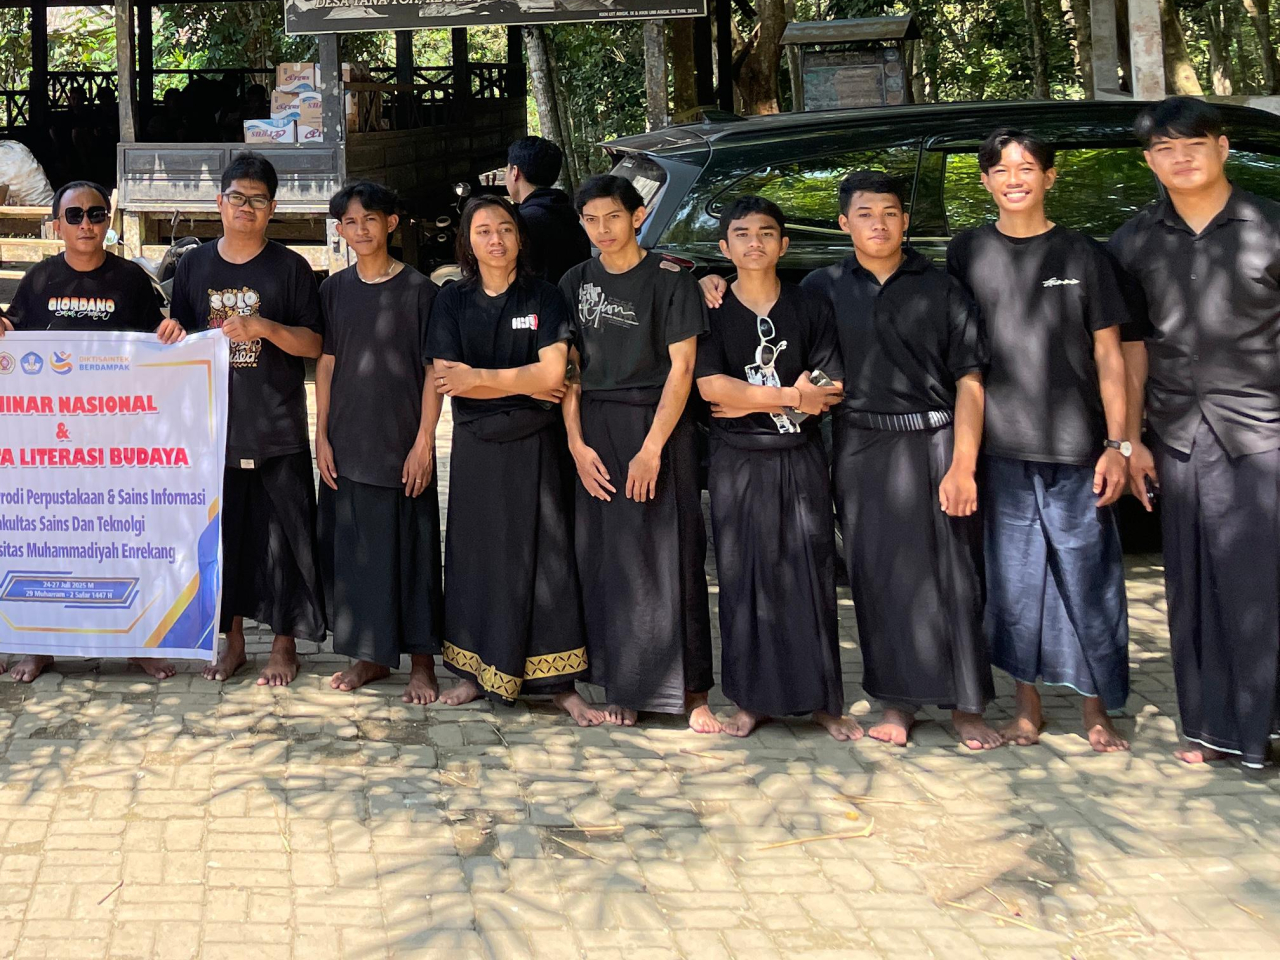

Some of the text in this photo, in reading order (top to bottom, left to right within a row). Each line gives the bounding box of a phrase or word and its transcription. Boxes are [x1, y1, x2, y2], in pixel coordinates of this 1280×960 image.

[48, 296, 115, 312] GIORDANO
[210, 292, 258, 310] SOLO
[78, 355, 130, 364] DIKTISAINTEK
[78, 363, 130, 372] BERDAMPAK
[58, 394, 158, 414] NASIONAL
[55, 422, 70, 441] &
[20, 447, 104, 467] LITERASI
[109, 447, 189, 467] BUDAYA
[26, 488, 105, 509] Perpustakaan
[107, 489, 116, 506] &
[117, 488, 149, 506] Sains
[150, 488, 206, 506] Informasi
[39, 515, 69, 532] Sains
[72, 516, 95, 532] Dan
[97, 515, 146, 537] Teknolgi
[26, 541, 120, 563] Muhammadiyah
[122, 542, 176, 564] Enrekang
[42, 580, 95, 589] 24-27 Juli 2025 M
[25, 589, 32, 598] 29
[33, 589, 66, 598] Muharram
[75, 590, 90, 598] Safar
[91, 590, 106, 599] 1447
[107, 591, 113, 599] H
